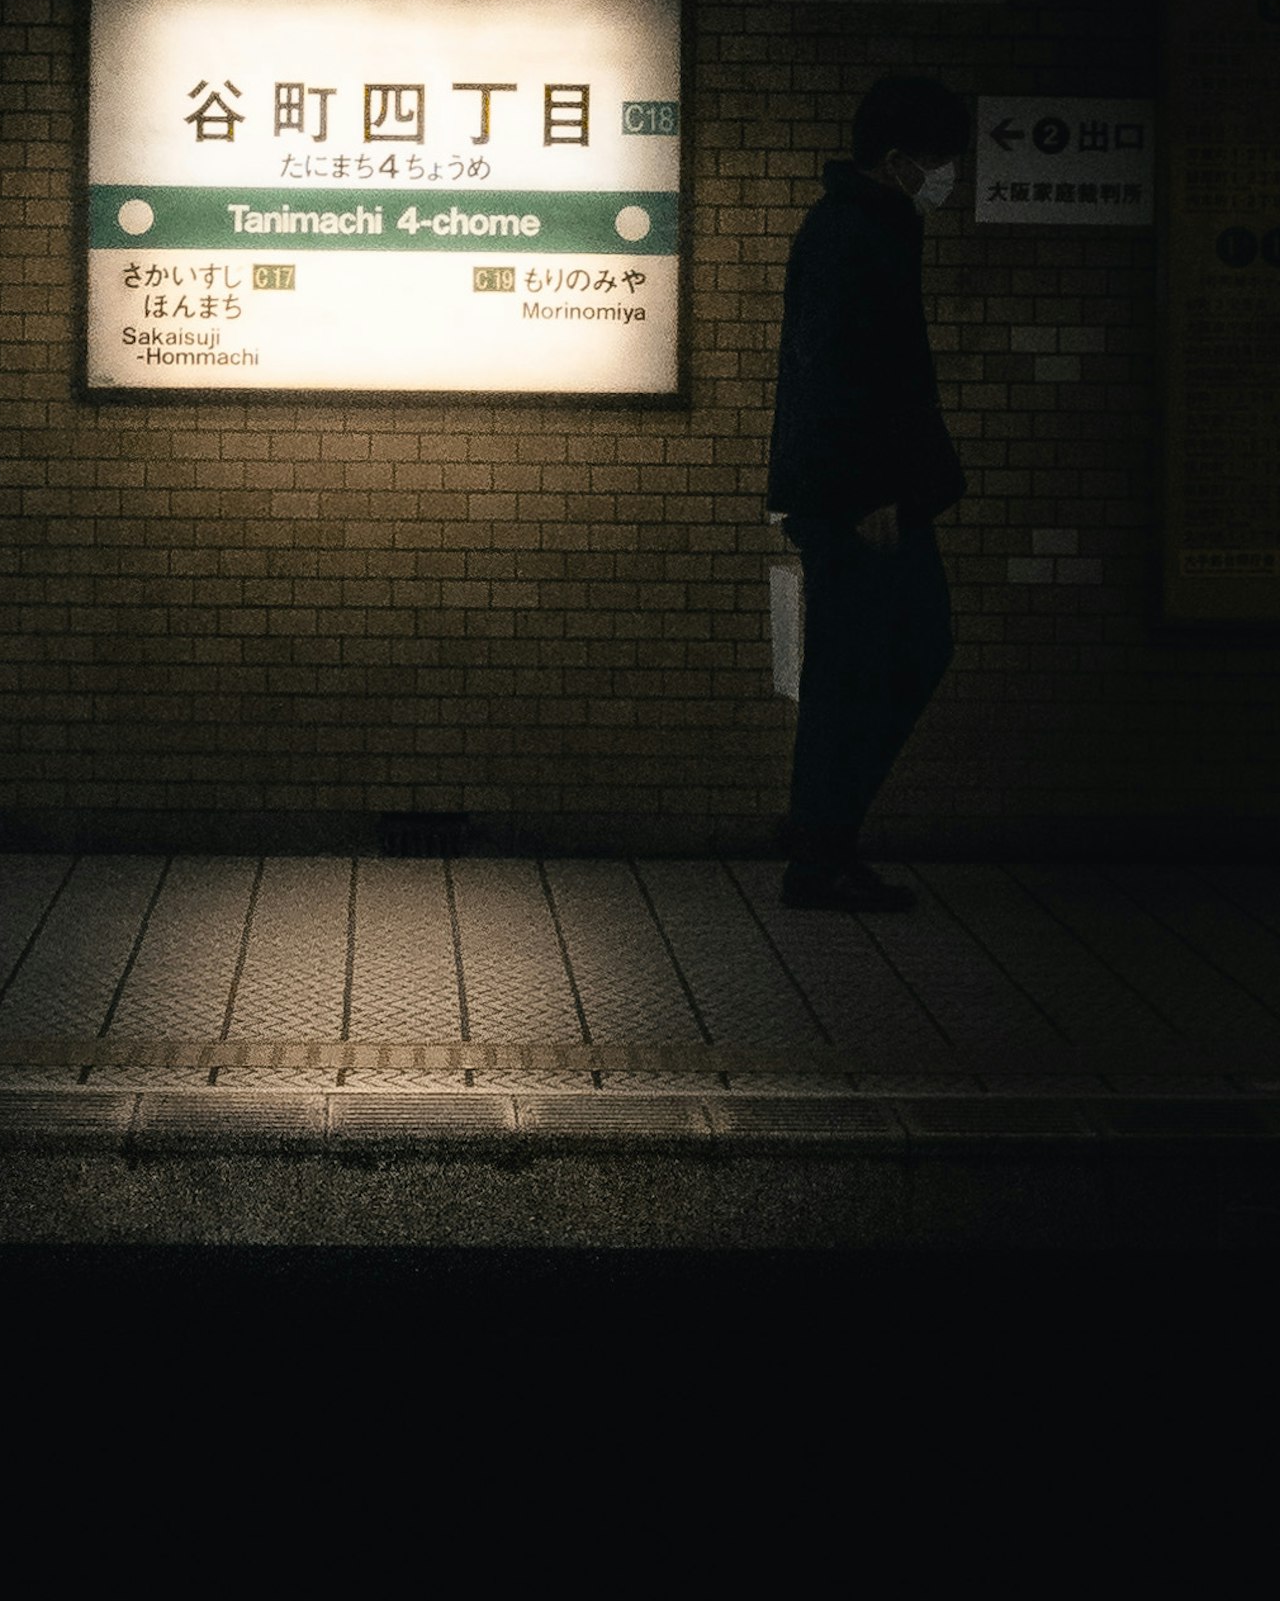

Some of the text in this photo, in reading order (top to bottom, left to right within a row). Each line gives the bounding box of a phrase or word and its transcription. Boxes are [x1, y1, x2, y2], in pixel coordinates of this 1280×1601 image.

[183, 79, 591, 147] 谷町四丁目
[624, 104, 674, 132] C18
[1078, 121, 1145, 151] 出口
[280, 152, 491, 181] たにまち4ちょうめ
[228, 203, 541, 237] Tanimachi 4-chome
[524, 267, 646, 294] もりのみや
[143, 293, 242, 320] ほんまち
[522, 302, 646, 325] Morinomiya
[122, 326, 220, 350] Sakaisuji
[136, 348, 260, 366] -Hommachi
